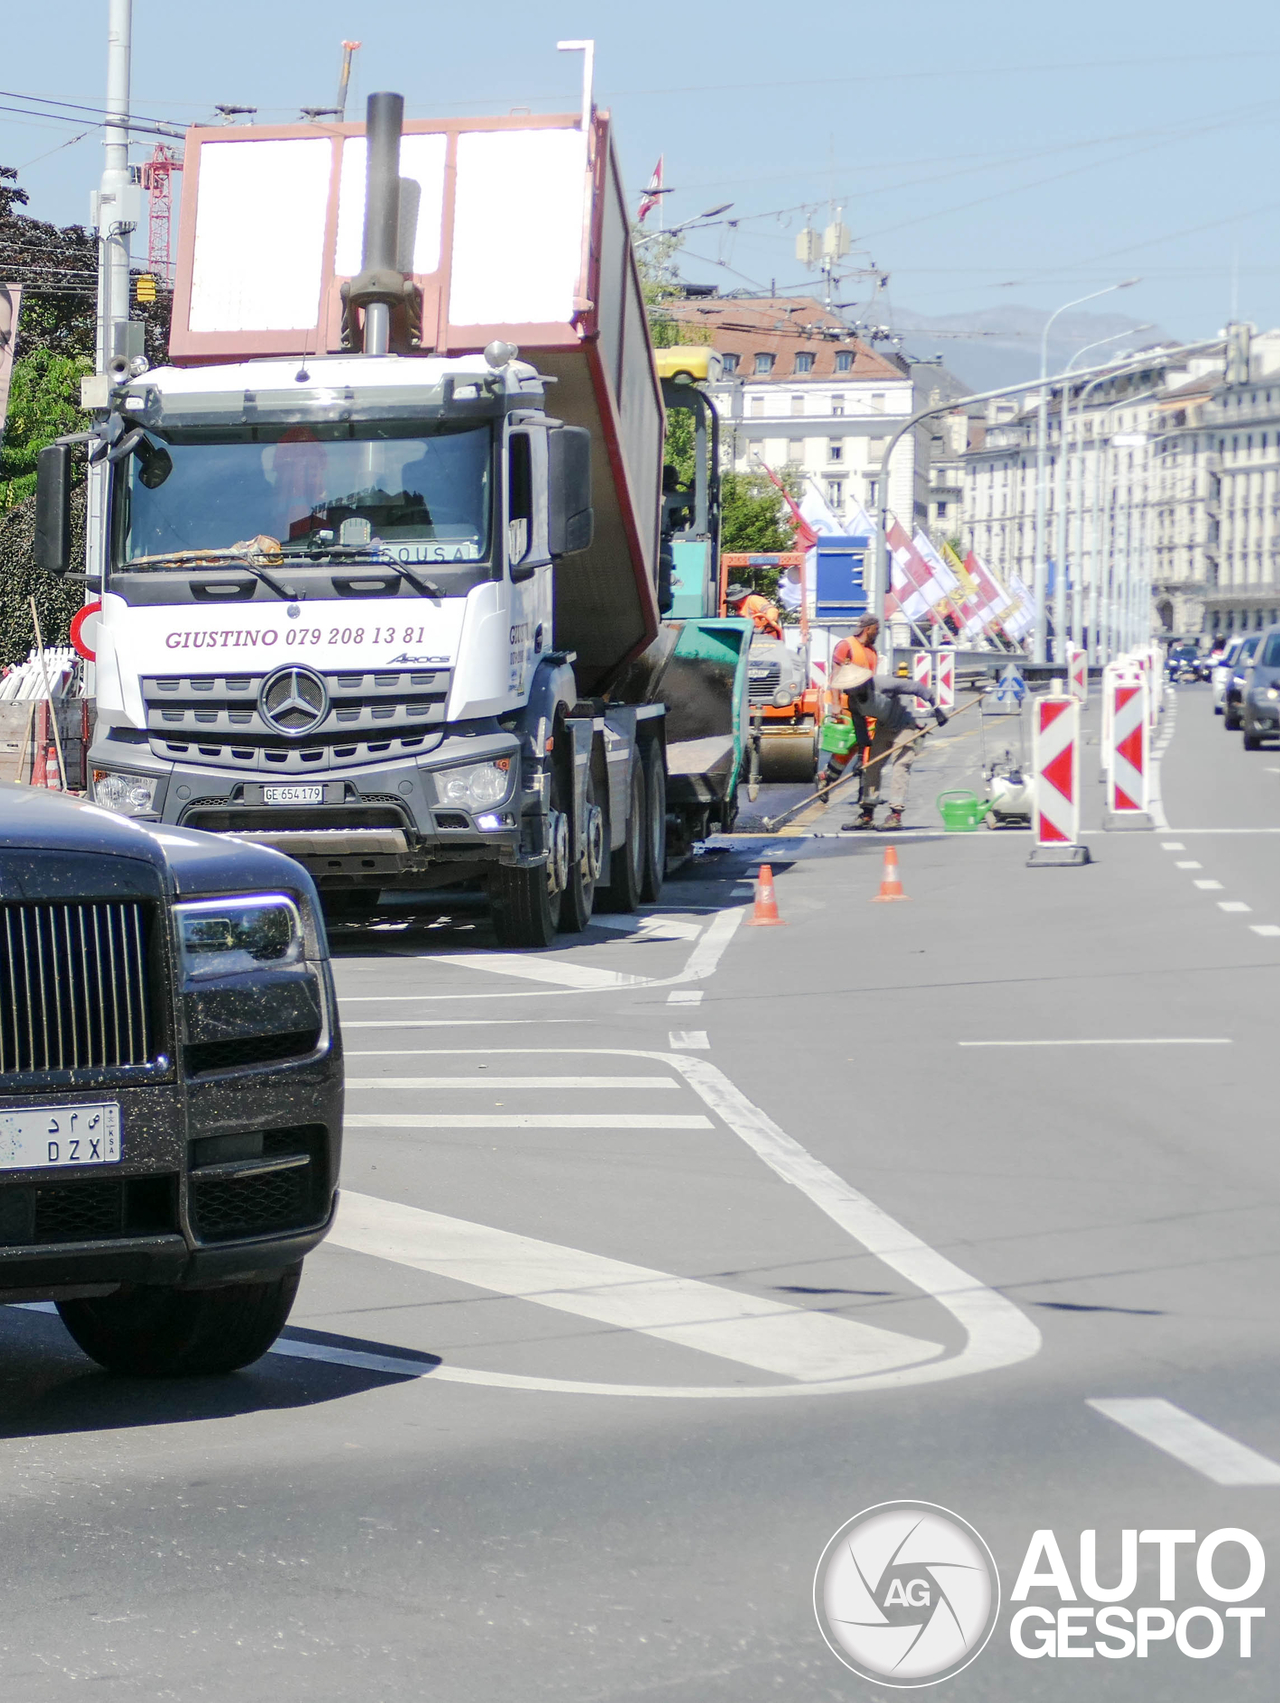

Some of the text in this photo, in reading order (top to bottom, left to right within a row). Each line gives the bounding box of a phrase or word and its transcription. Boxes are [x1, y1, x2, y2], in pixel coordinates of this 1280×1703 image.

[165, 627, 425, 648] GIUSTINO 079 208 13 81
